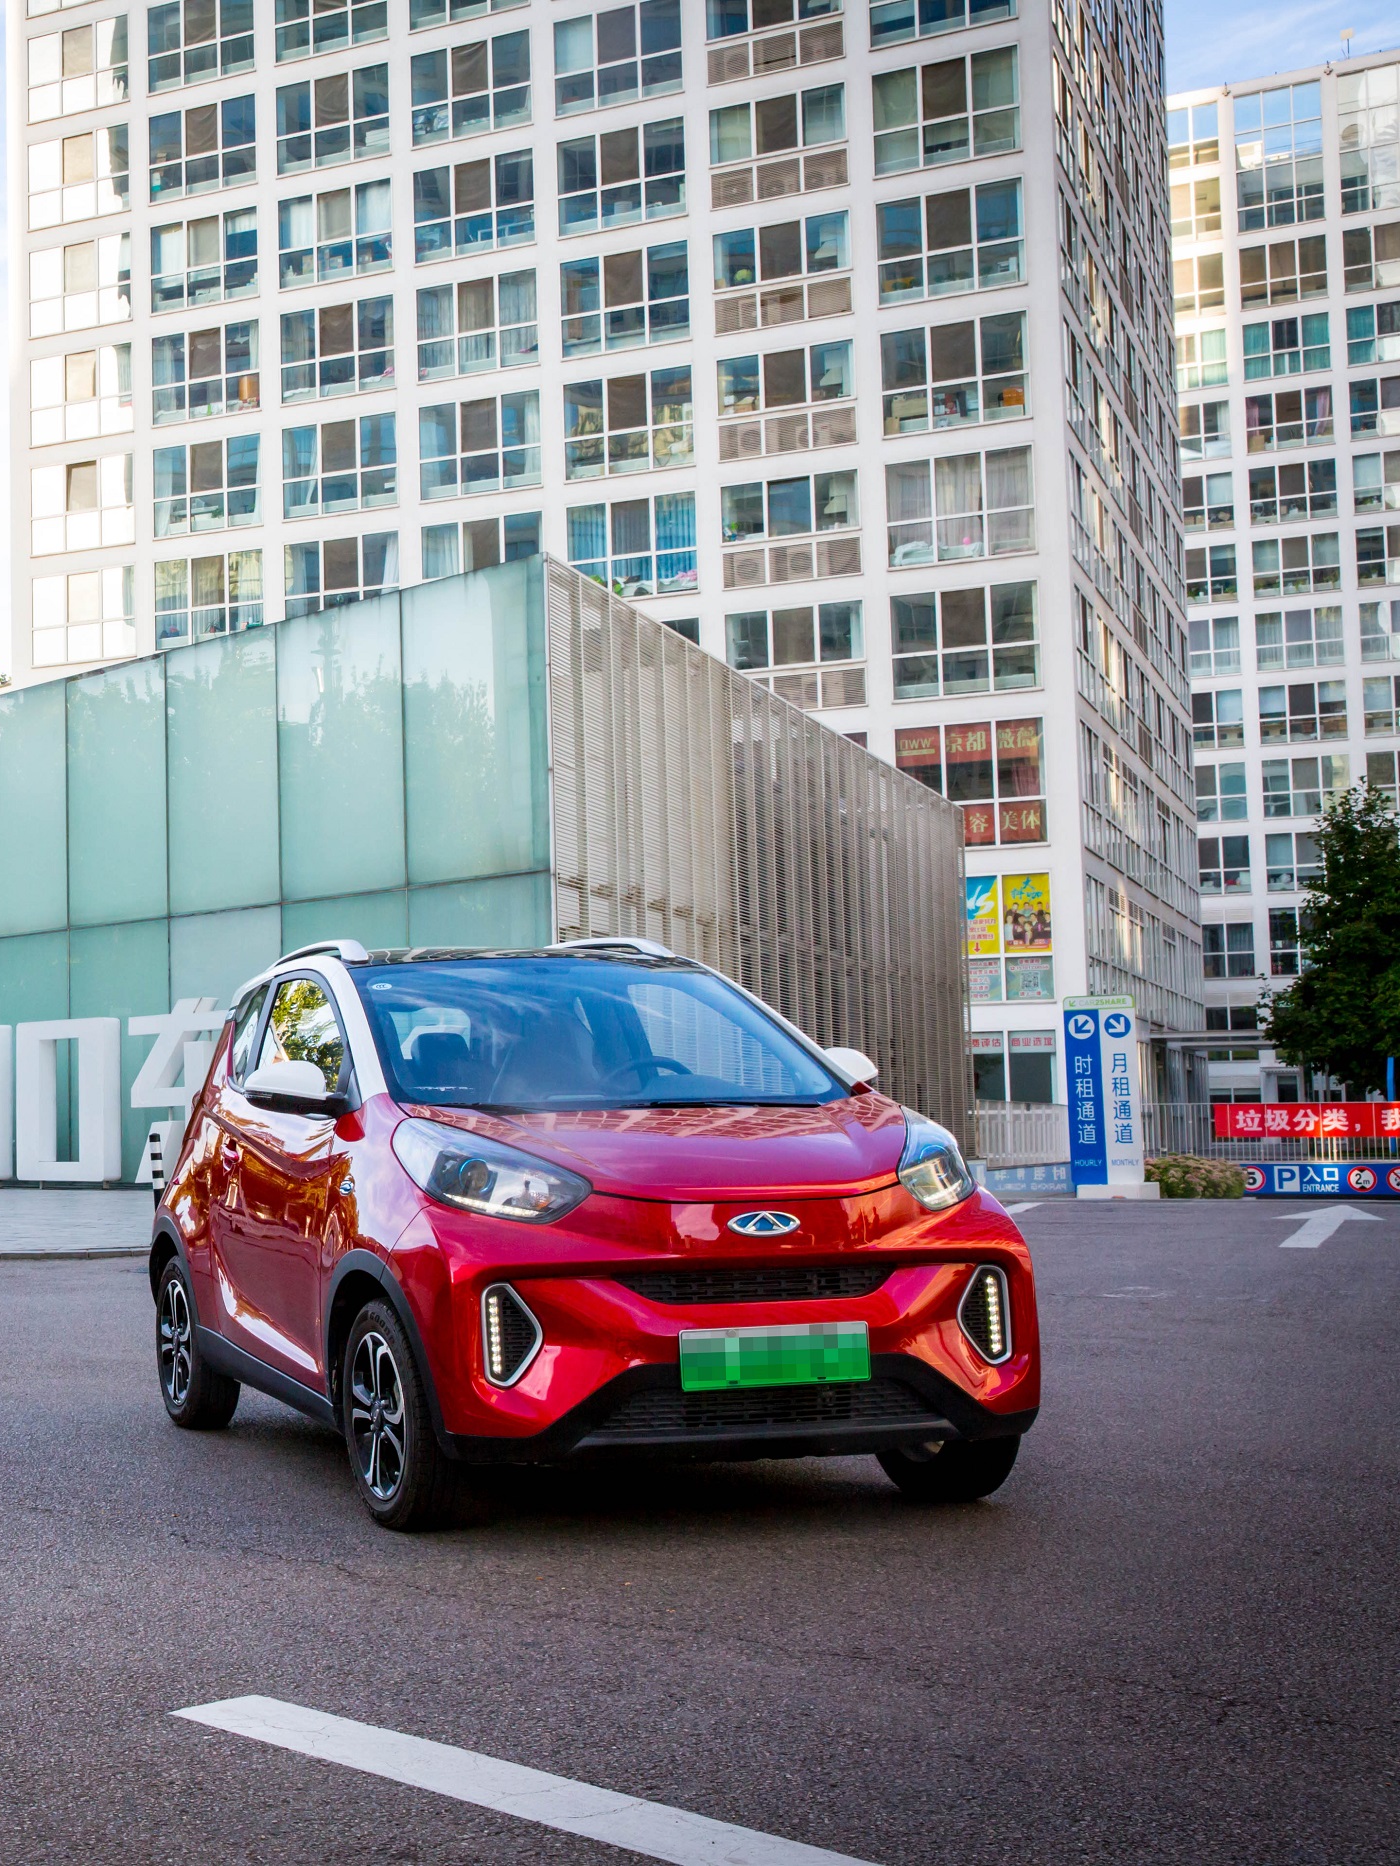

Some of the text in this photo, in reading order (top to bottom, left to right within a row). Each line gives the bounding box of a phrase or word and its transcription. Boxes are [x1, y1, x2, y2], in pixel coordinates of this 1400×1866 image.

[964, 809, 1040, 834] 容美体
[1074, 1055, 1097, 1145] 时租通道
[1111, 1053, 1134, 1144] 月租通道
[1074, 1158, 1102, 1167] HOURLY
[1111, 1158, 1139, 1167] MONTHLY
[1277, 1168, 1297, 1190] P
[1303, 1167, 1339, 1182] 入口
[1302, 1183, 1340, 1193] ENTRANCE
